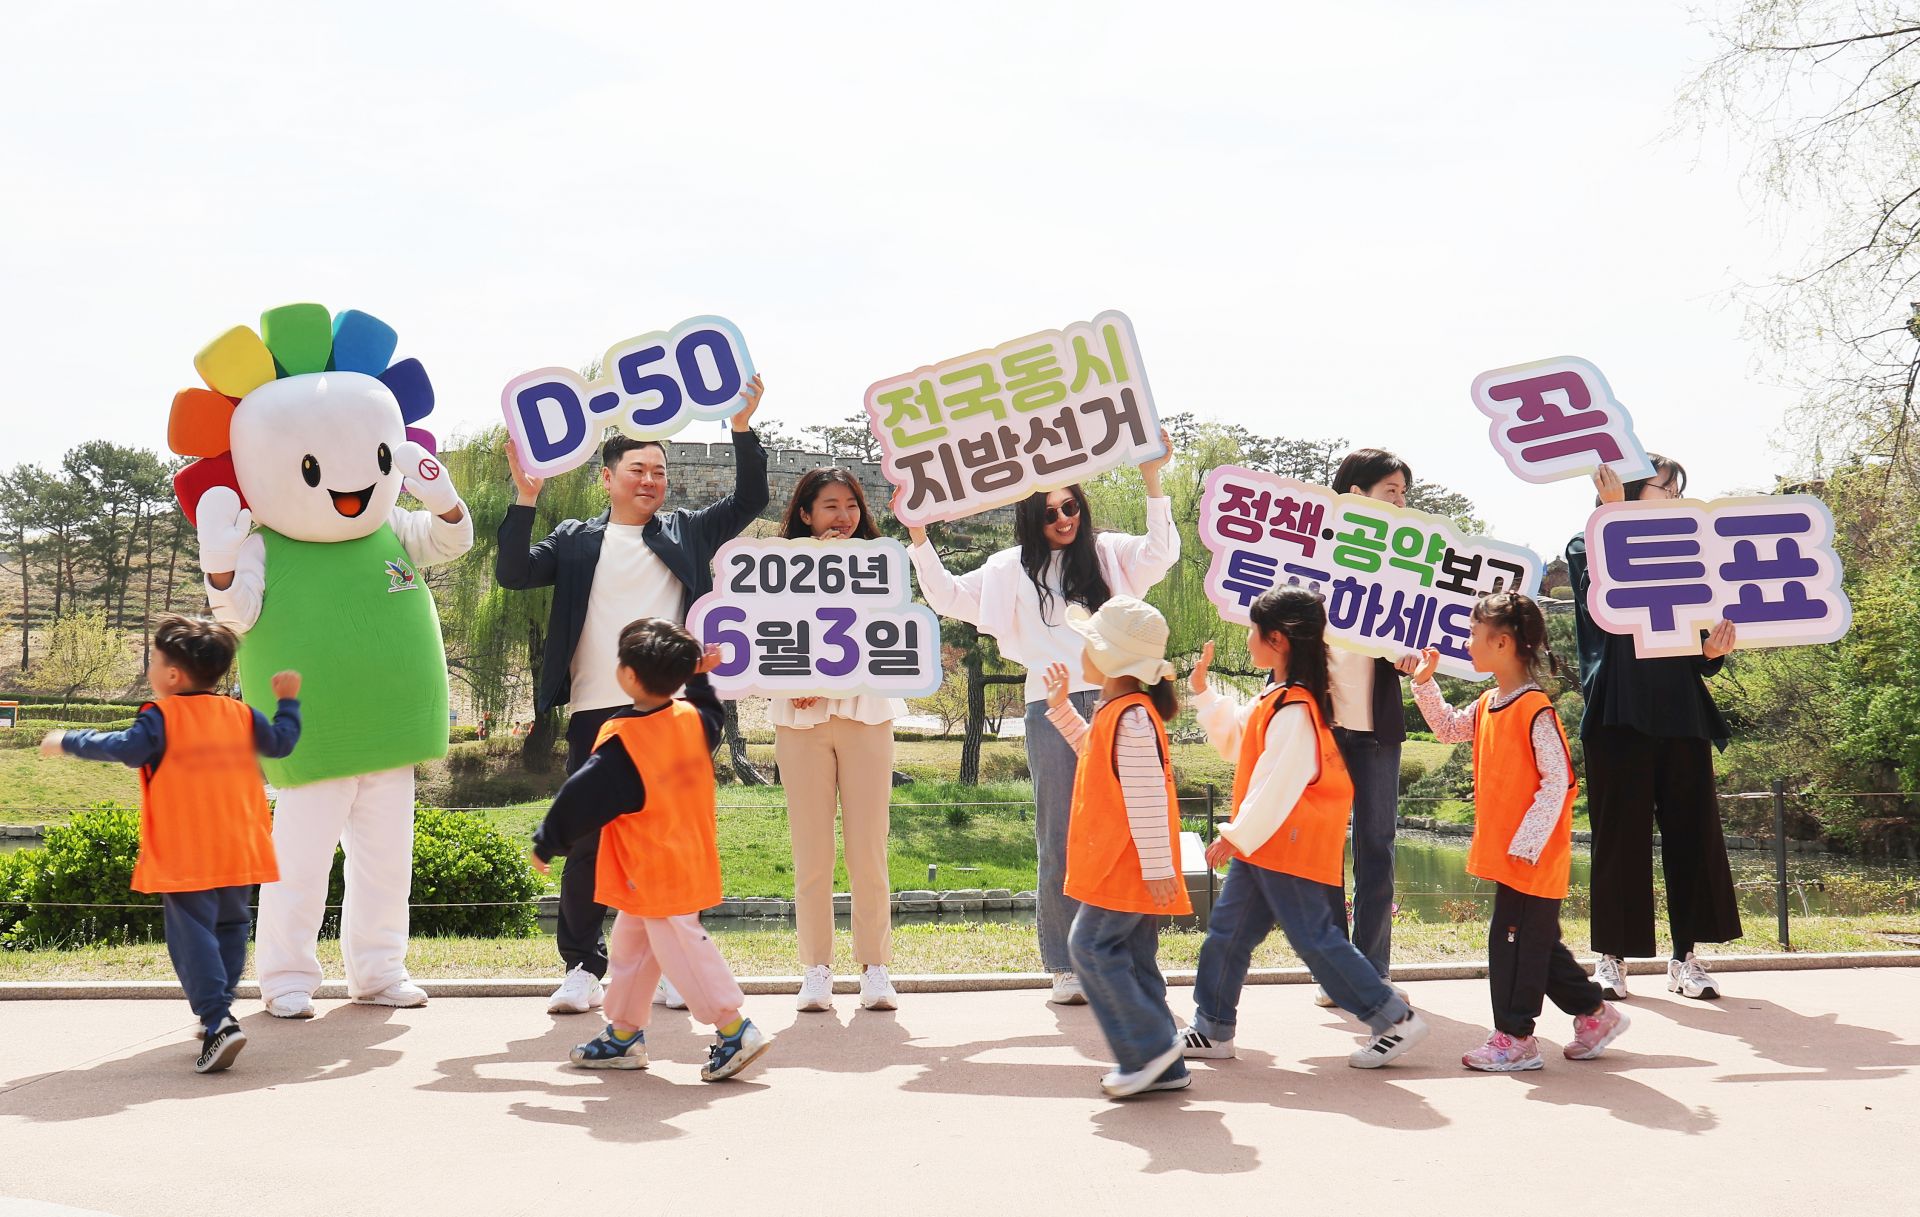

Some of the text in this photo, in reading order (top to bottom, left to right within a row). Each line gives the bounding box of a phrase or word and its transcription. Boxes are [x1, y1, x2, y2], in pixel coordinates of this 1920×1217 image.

[517, 332, 740, 462] D-50
[877, 324, 1129, 448] 전국동시
[1489, 371, 1622, 462] 꼭
[895, 388, 1148, 510] 지방선거
[730, 553, 890, 595] 2026년
[1603, 513, 1828, 632] 투표
